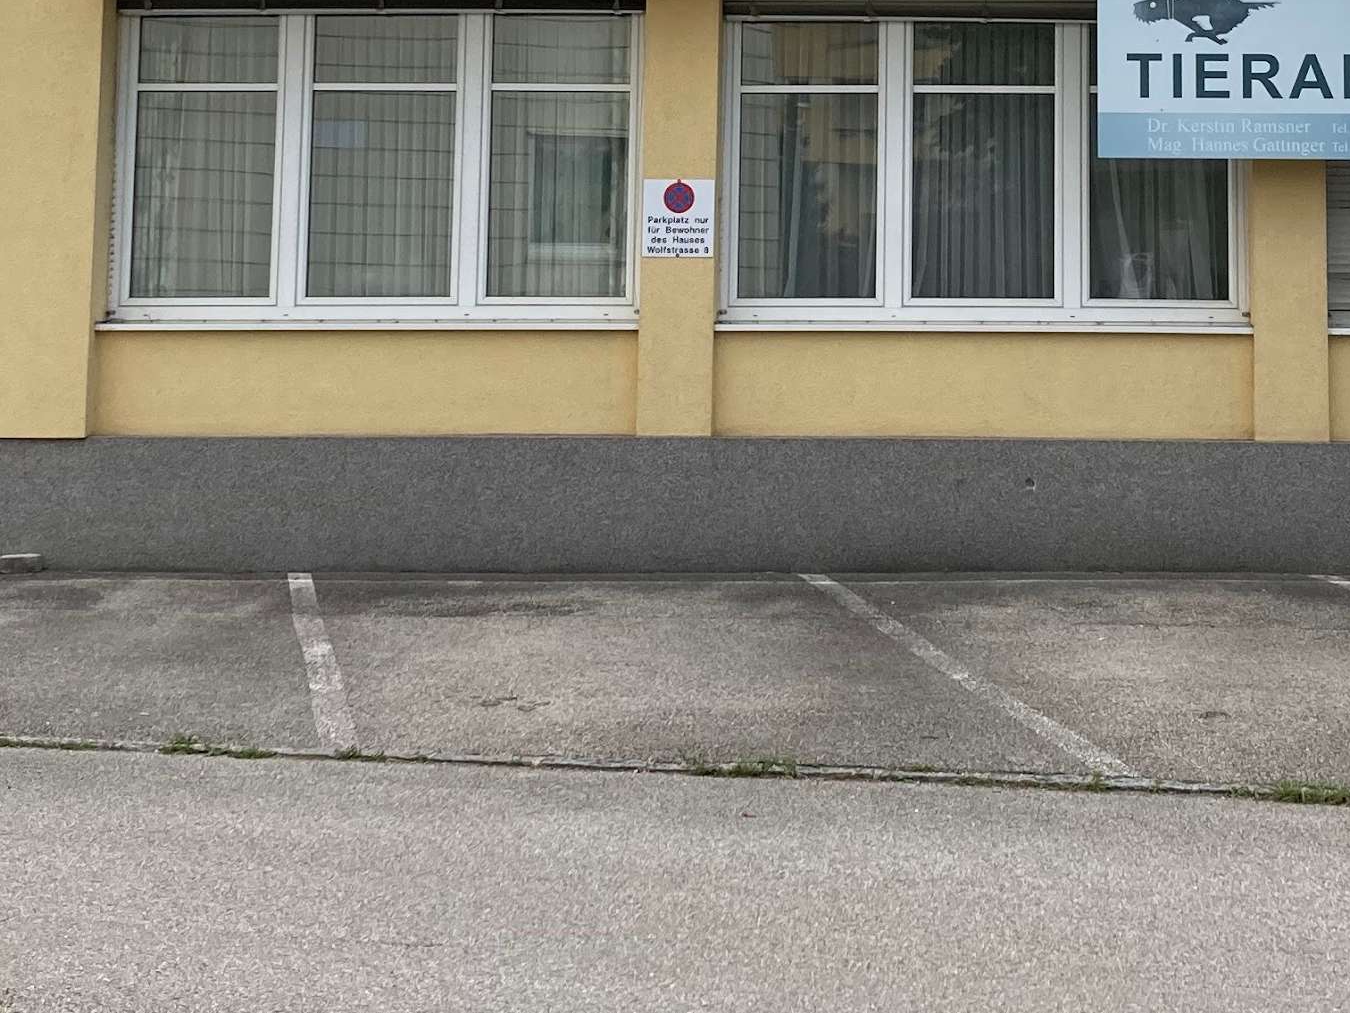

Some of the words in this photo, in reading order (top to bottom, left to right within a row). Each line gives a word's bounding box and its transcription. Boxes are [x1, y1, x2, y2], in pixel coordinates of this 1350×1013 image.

[1177, 118, 1236, 133] Kerstin
[1241, 118, 1312, 133] Ramsner
[1192, 137, 1249, 152] Hannes
[647, 216, 689, 225] Parkplatz
[647, 226, 660, 234] für
[665, 226, 709, 234] Bewohner
[651, 236, 667, 244] des
[673, 236, 705, 244] Hauses
[647, 246, 699, 254] Wolfstrasse
